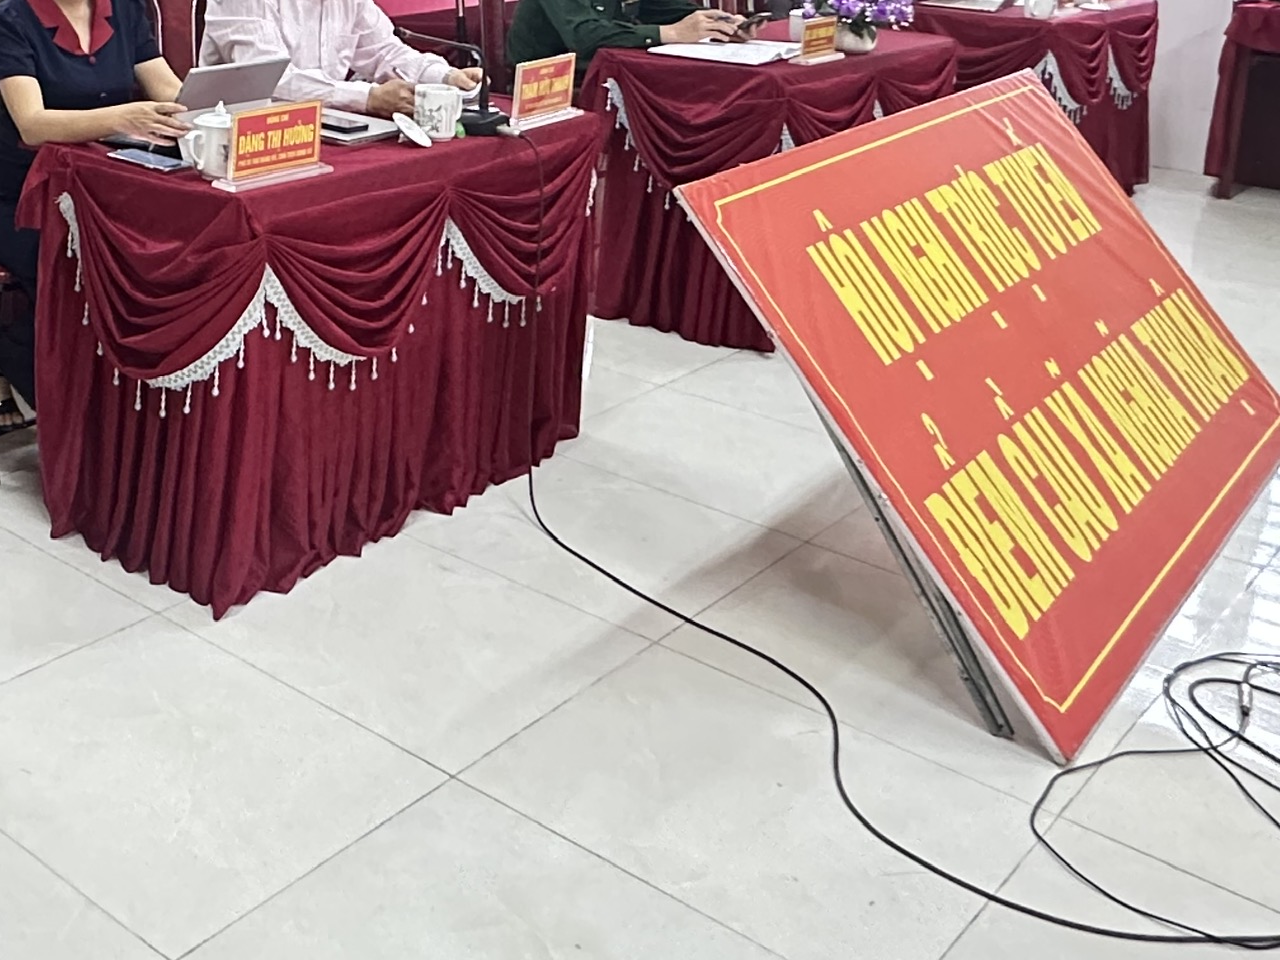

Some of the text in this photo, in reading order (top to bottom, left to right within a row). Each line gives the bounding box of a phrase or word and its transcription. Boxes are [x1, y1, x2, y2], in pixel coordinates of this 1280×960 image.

[806, 117, 1103, 380] HỘI NGHỊ TRỰC TUYẾN
[921, 278, 1255, 640] ĐIỂM CẦU XÃ NGHĨA THUẬN
